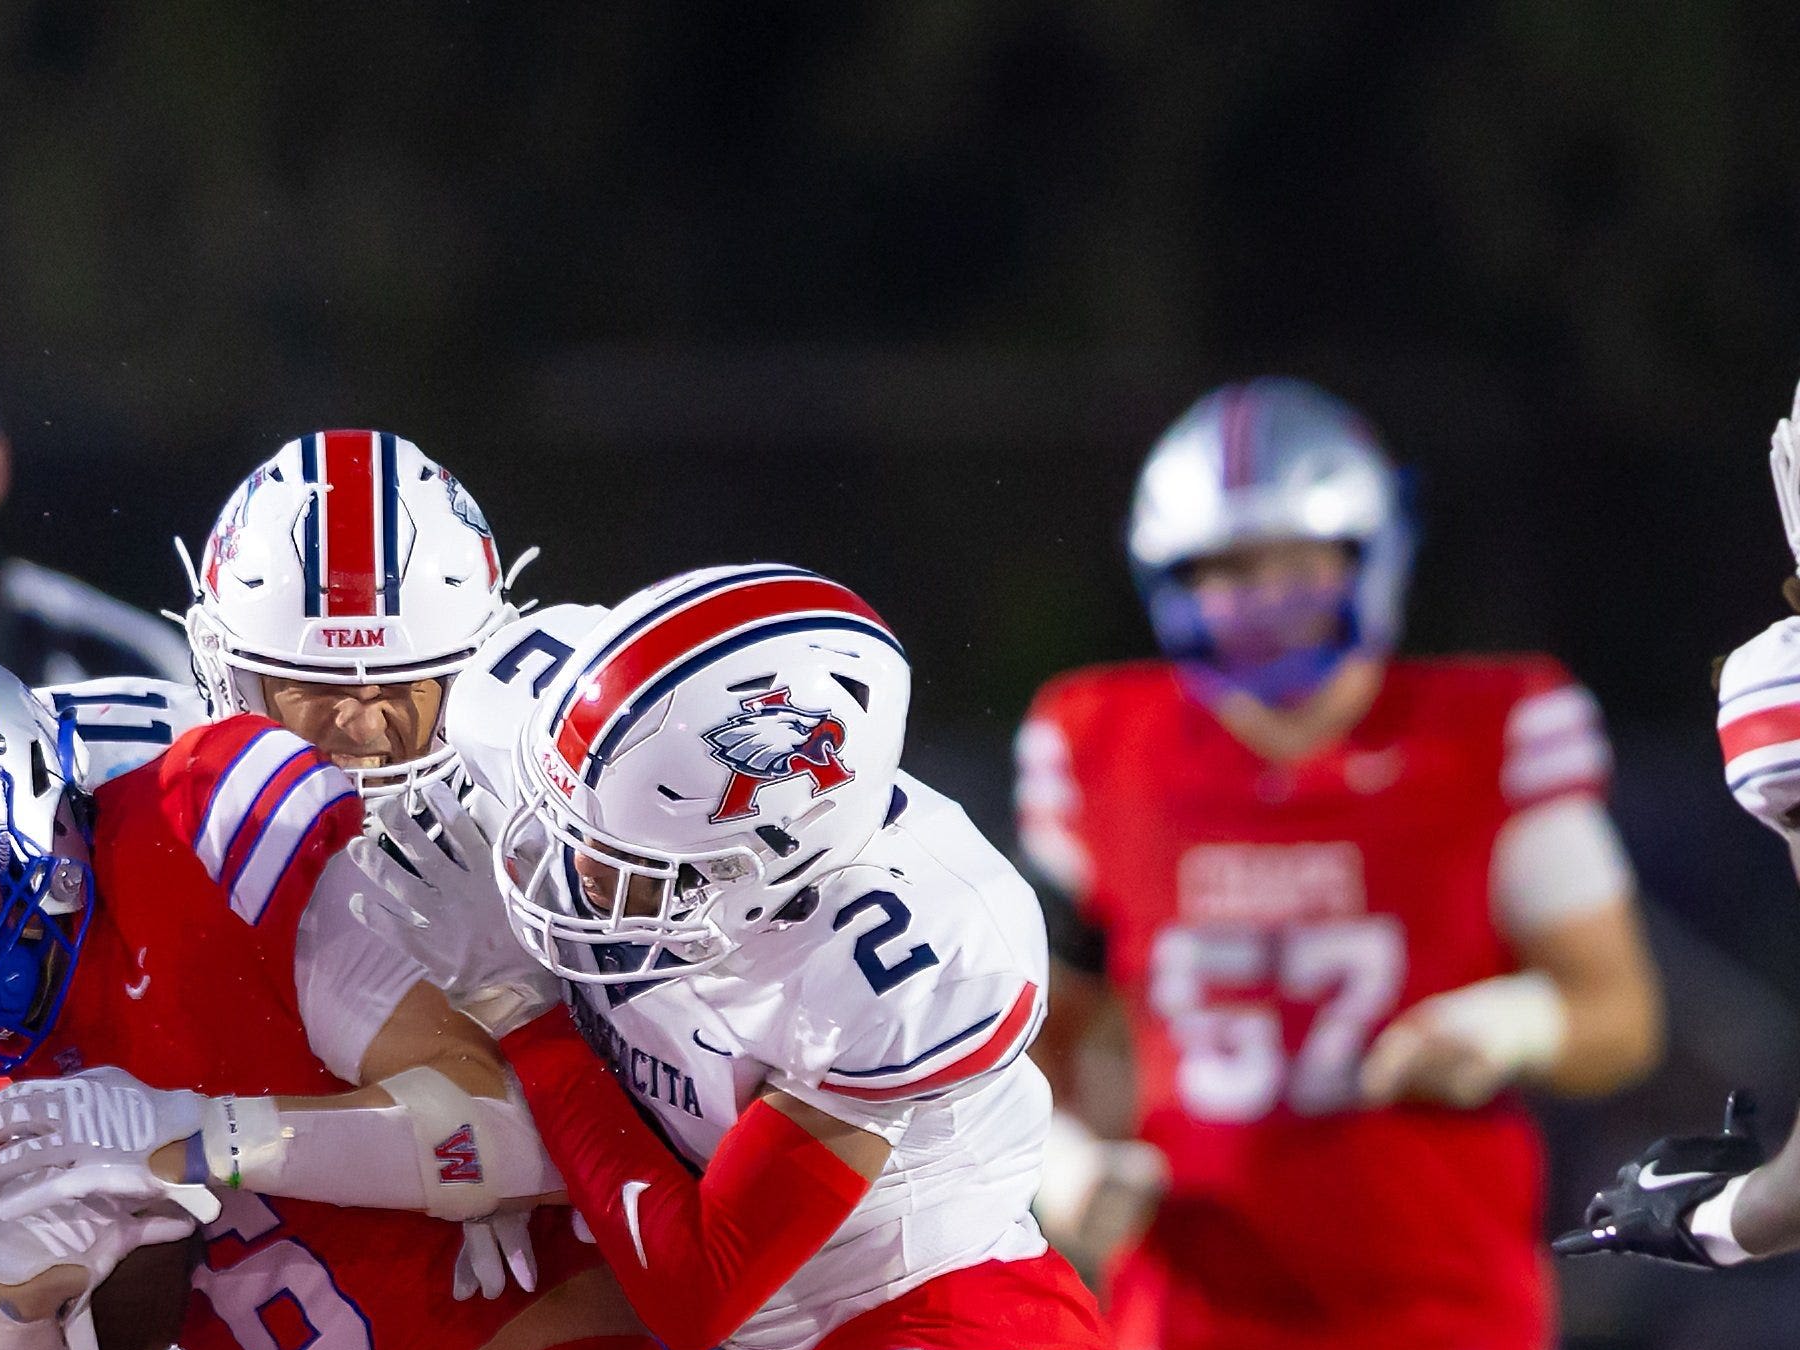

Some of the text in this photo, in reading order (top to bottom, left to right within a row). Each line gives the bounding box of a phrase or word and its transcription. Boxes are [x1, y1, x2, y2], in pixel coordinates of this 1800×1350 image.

[323, 627, 385, 648] TEAM
[51, 692, 175, 745] 11
[832, 890, 941, 997] 2
[1152, 912, 1408, 1122] 57
